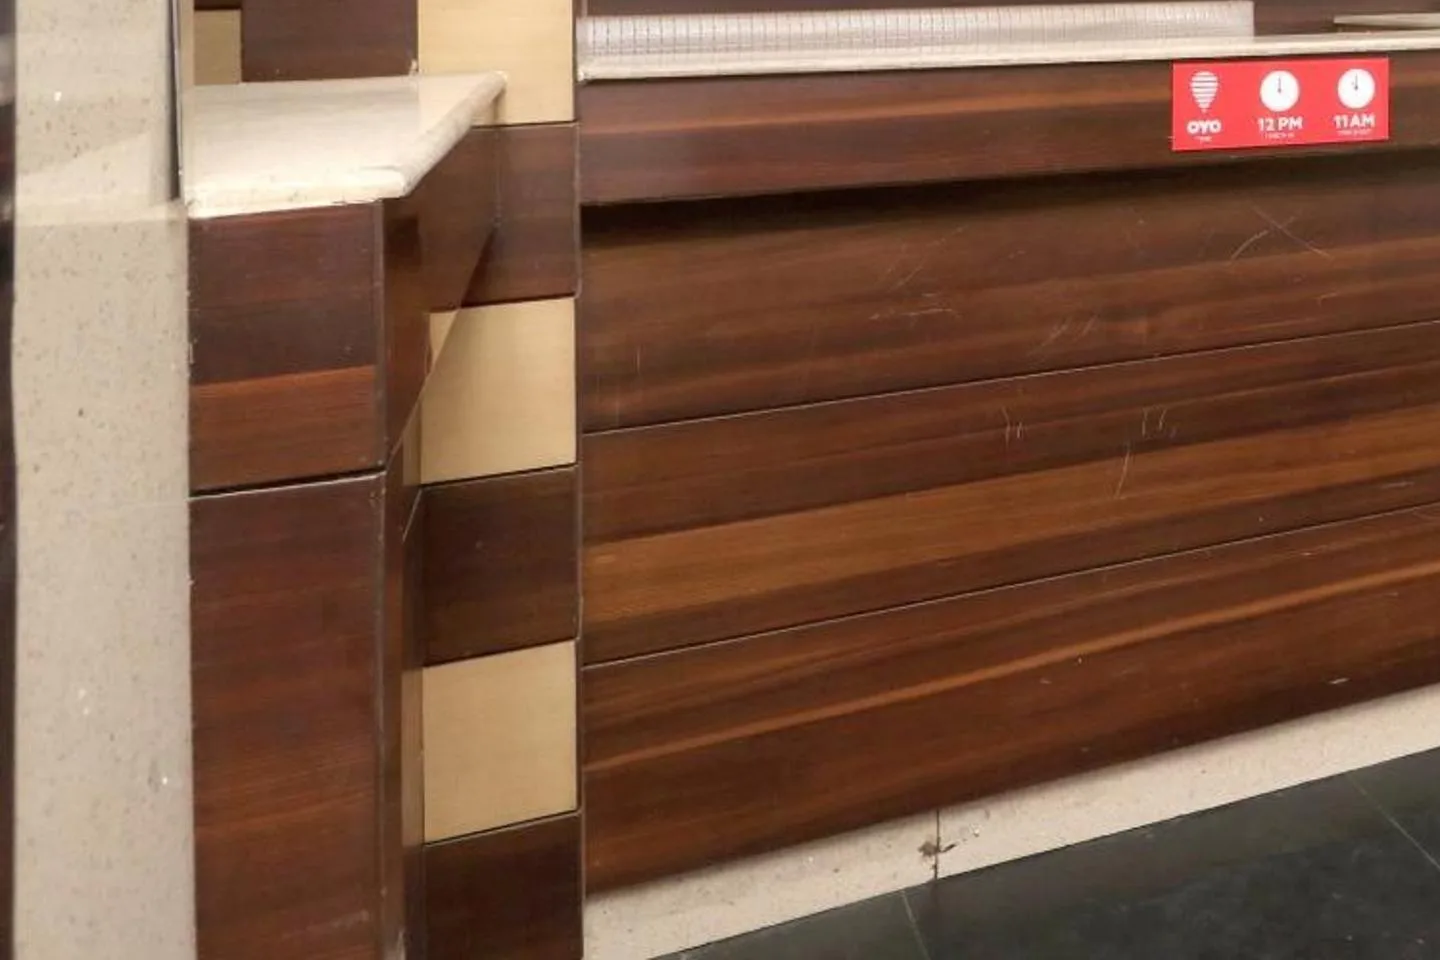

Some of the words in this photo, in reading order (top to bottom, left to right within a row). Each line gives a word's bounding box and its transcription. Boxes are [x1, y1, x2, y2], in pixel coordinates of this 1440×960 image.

[1186, 119, 1222, 134] OYO
[1258, 117, 1275, 132] 12
[1278, 115, 1304, 131] PM
